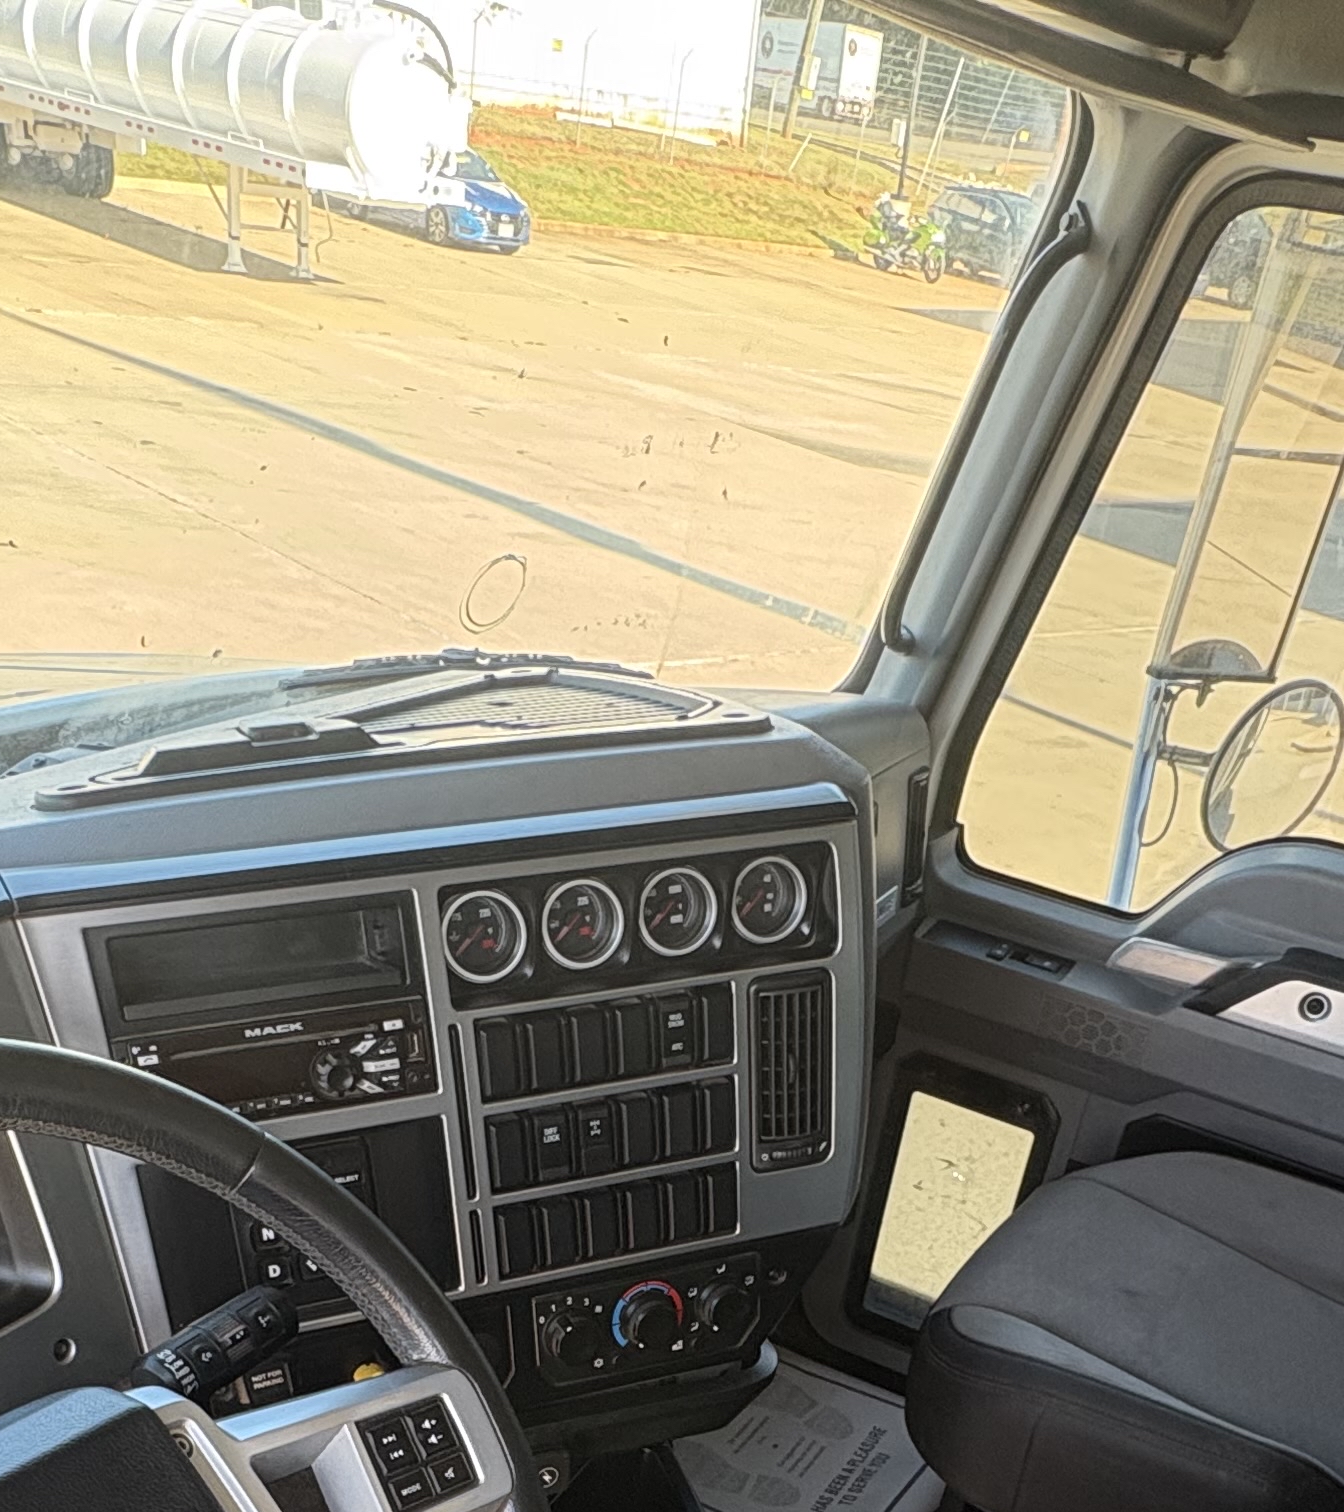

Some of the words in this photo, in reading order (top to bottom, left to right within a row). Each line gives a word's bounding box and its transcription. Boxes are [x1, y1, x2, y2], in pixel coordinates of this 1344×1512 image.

[244, 1022, 304, 1039] MACK
[261, 1228, 275, 1241] N
[268, 1264, 281, 1278] D
[825, 1473, 850, 1497] BEEN
[847, 1425, 887, 1468] PLEASURE
[870, 1452, 891, 1471] YOU
